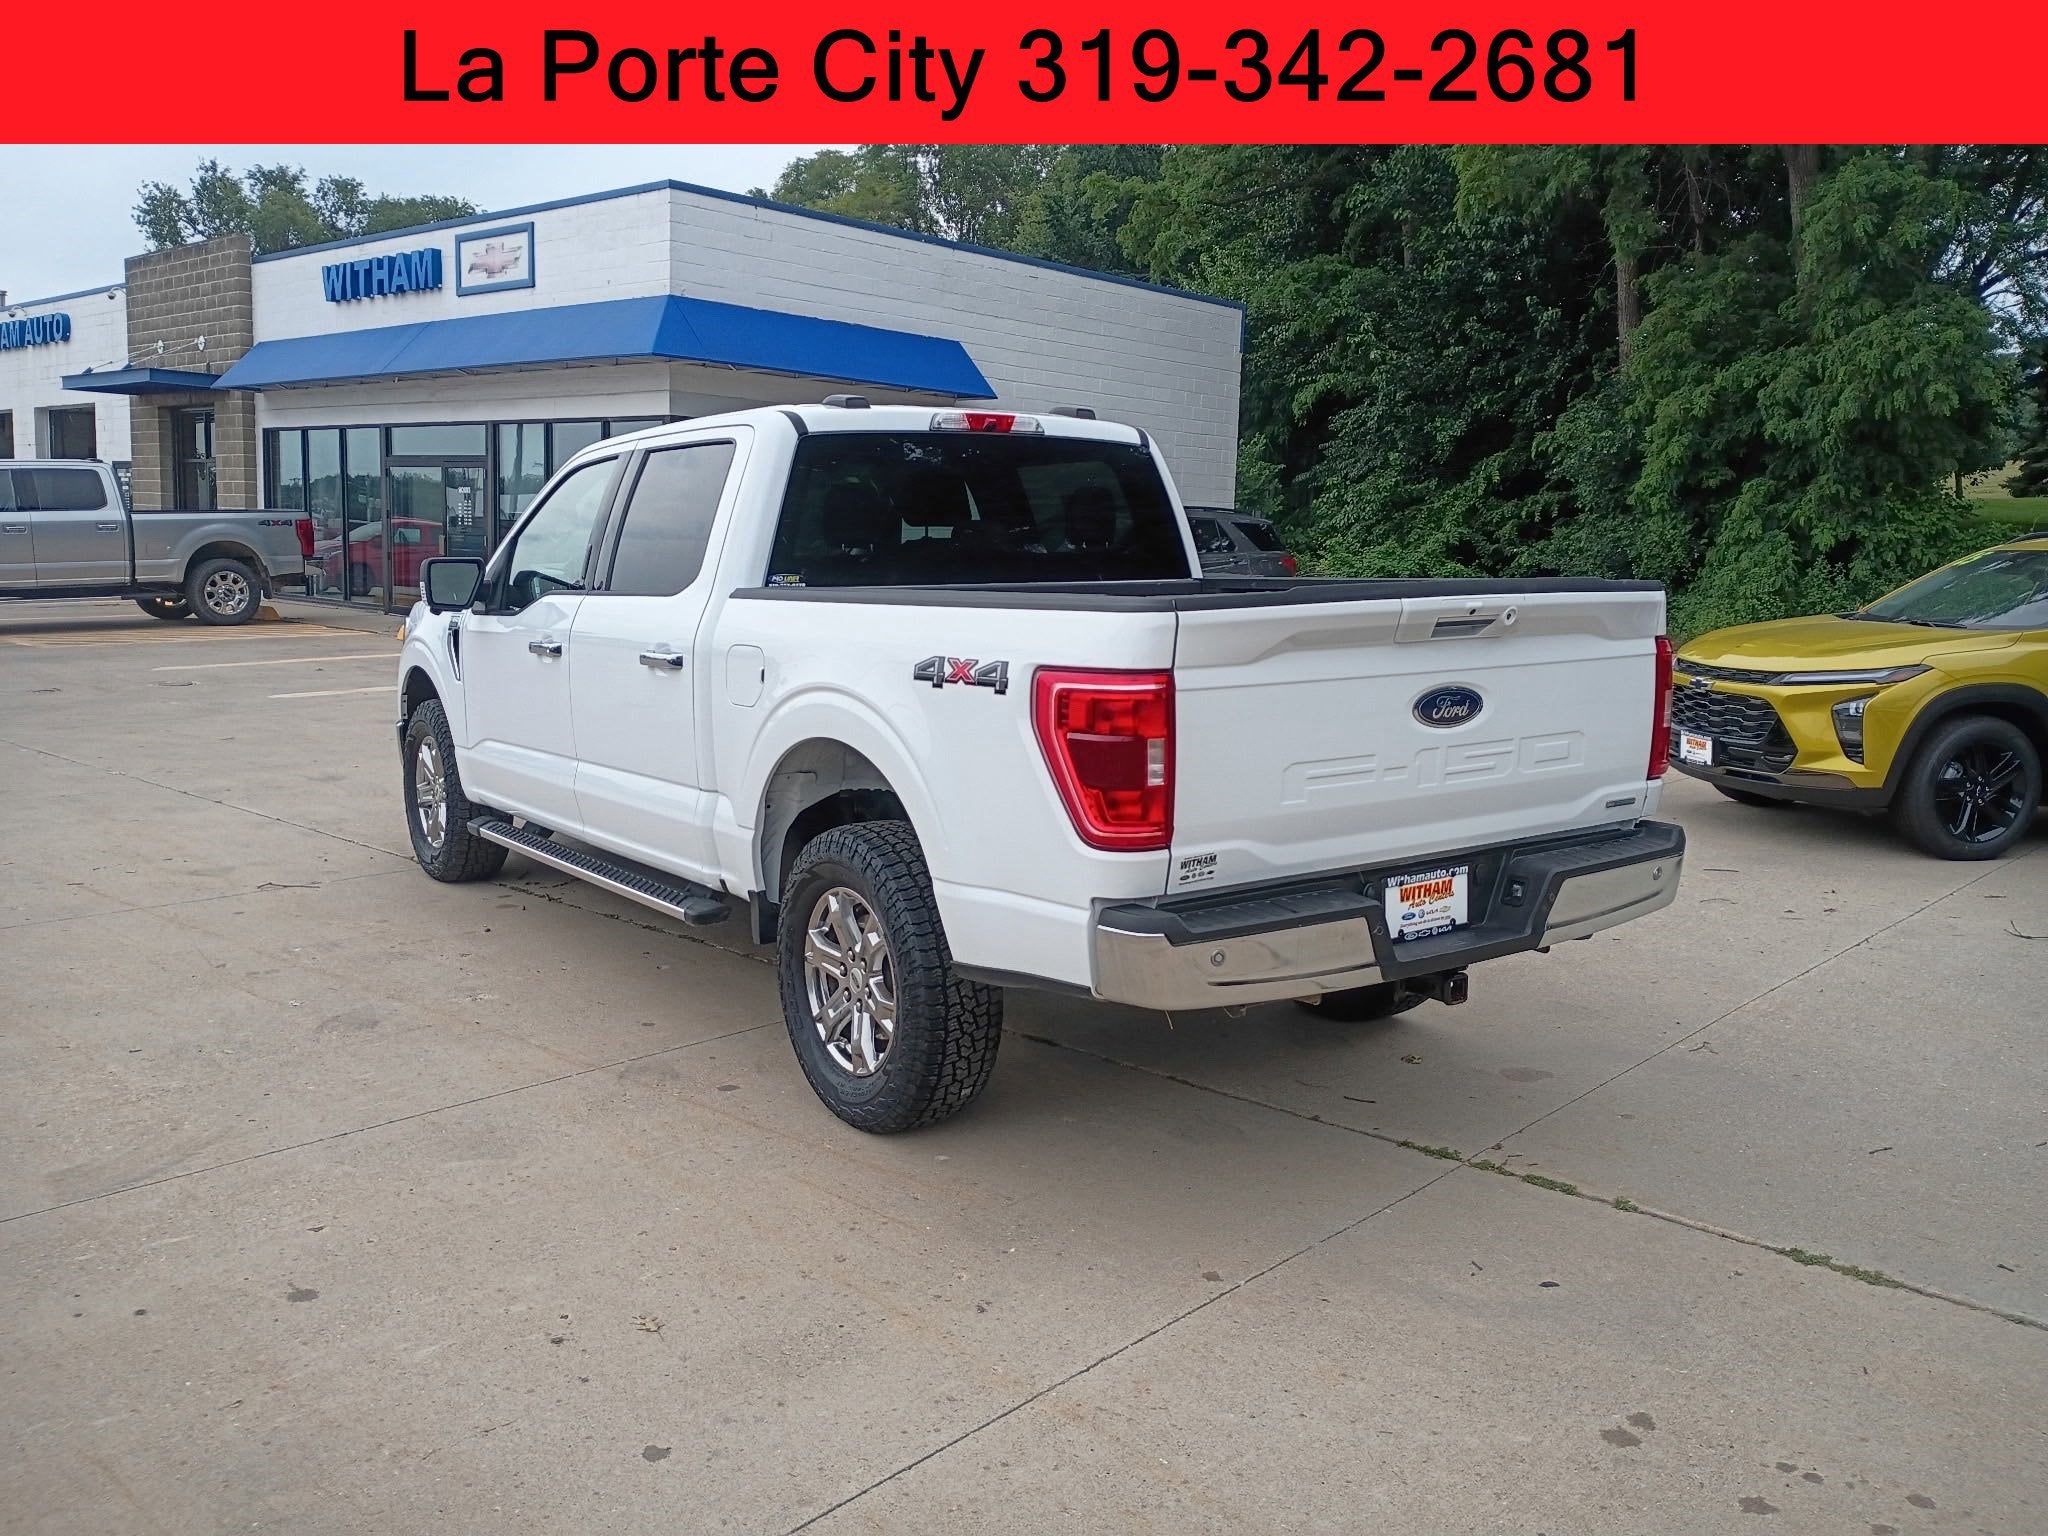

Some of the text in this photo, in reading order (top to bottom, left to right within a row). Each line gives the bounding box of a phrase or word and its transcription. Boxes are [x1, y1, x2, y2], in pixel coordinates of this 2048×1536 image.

[322, 248, 441, 302] WITHAM
[25, 312, 68, 347] AUTO
[1432, 695, 1471, 719] Ford
[1281, 730, 1585, 806] F-150
[1180, 854, 1217, 870] WITHAM
[1400, 878, 1454, 903] WITHAM
